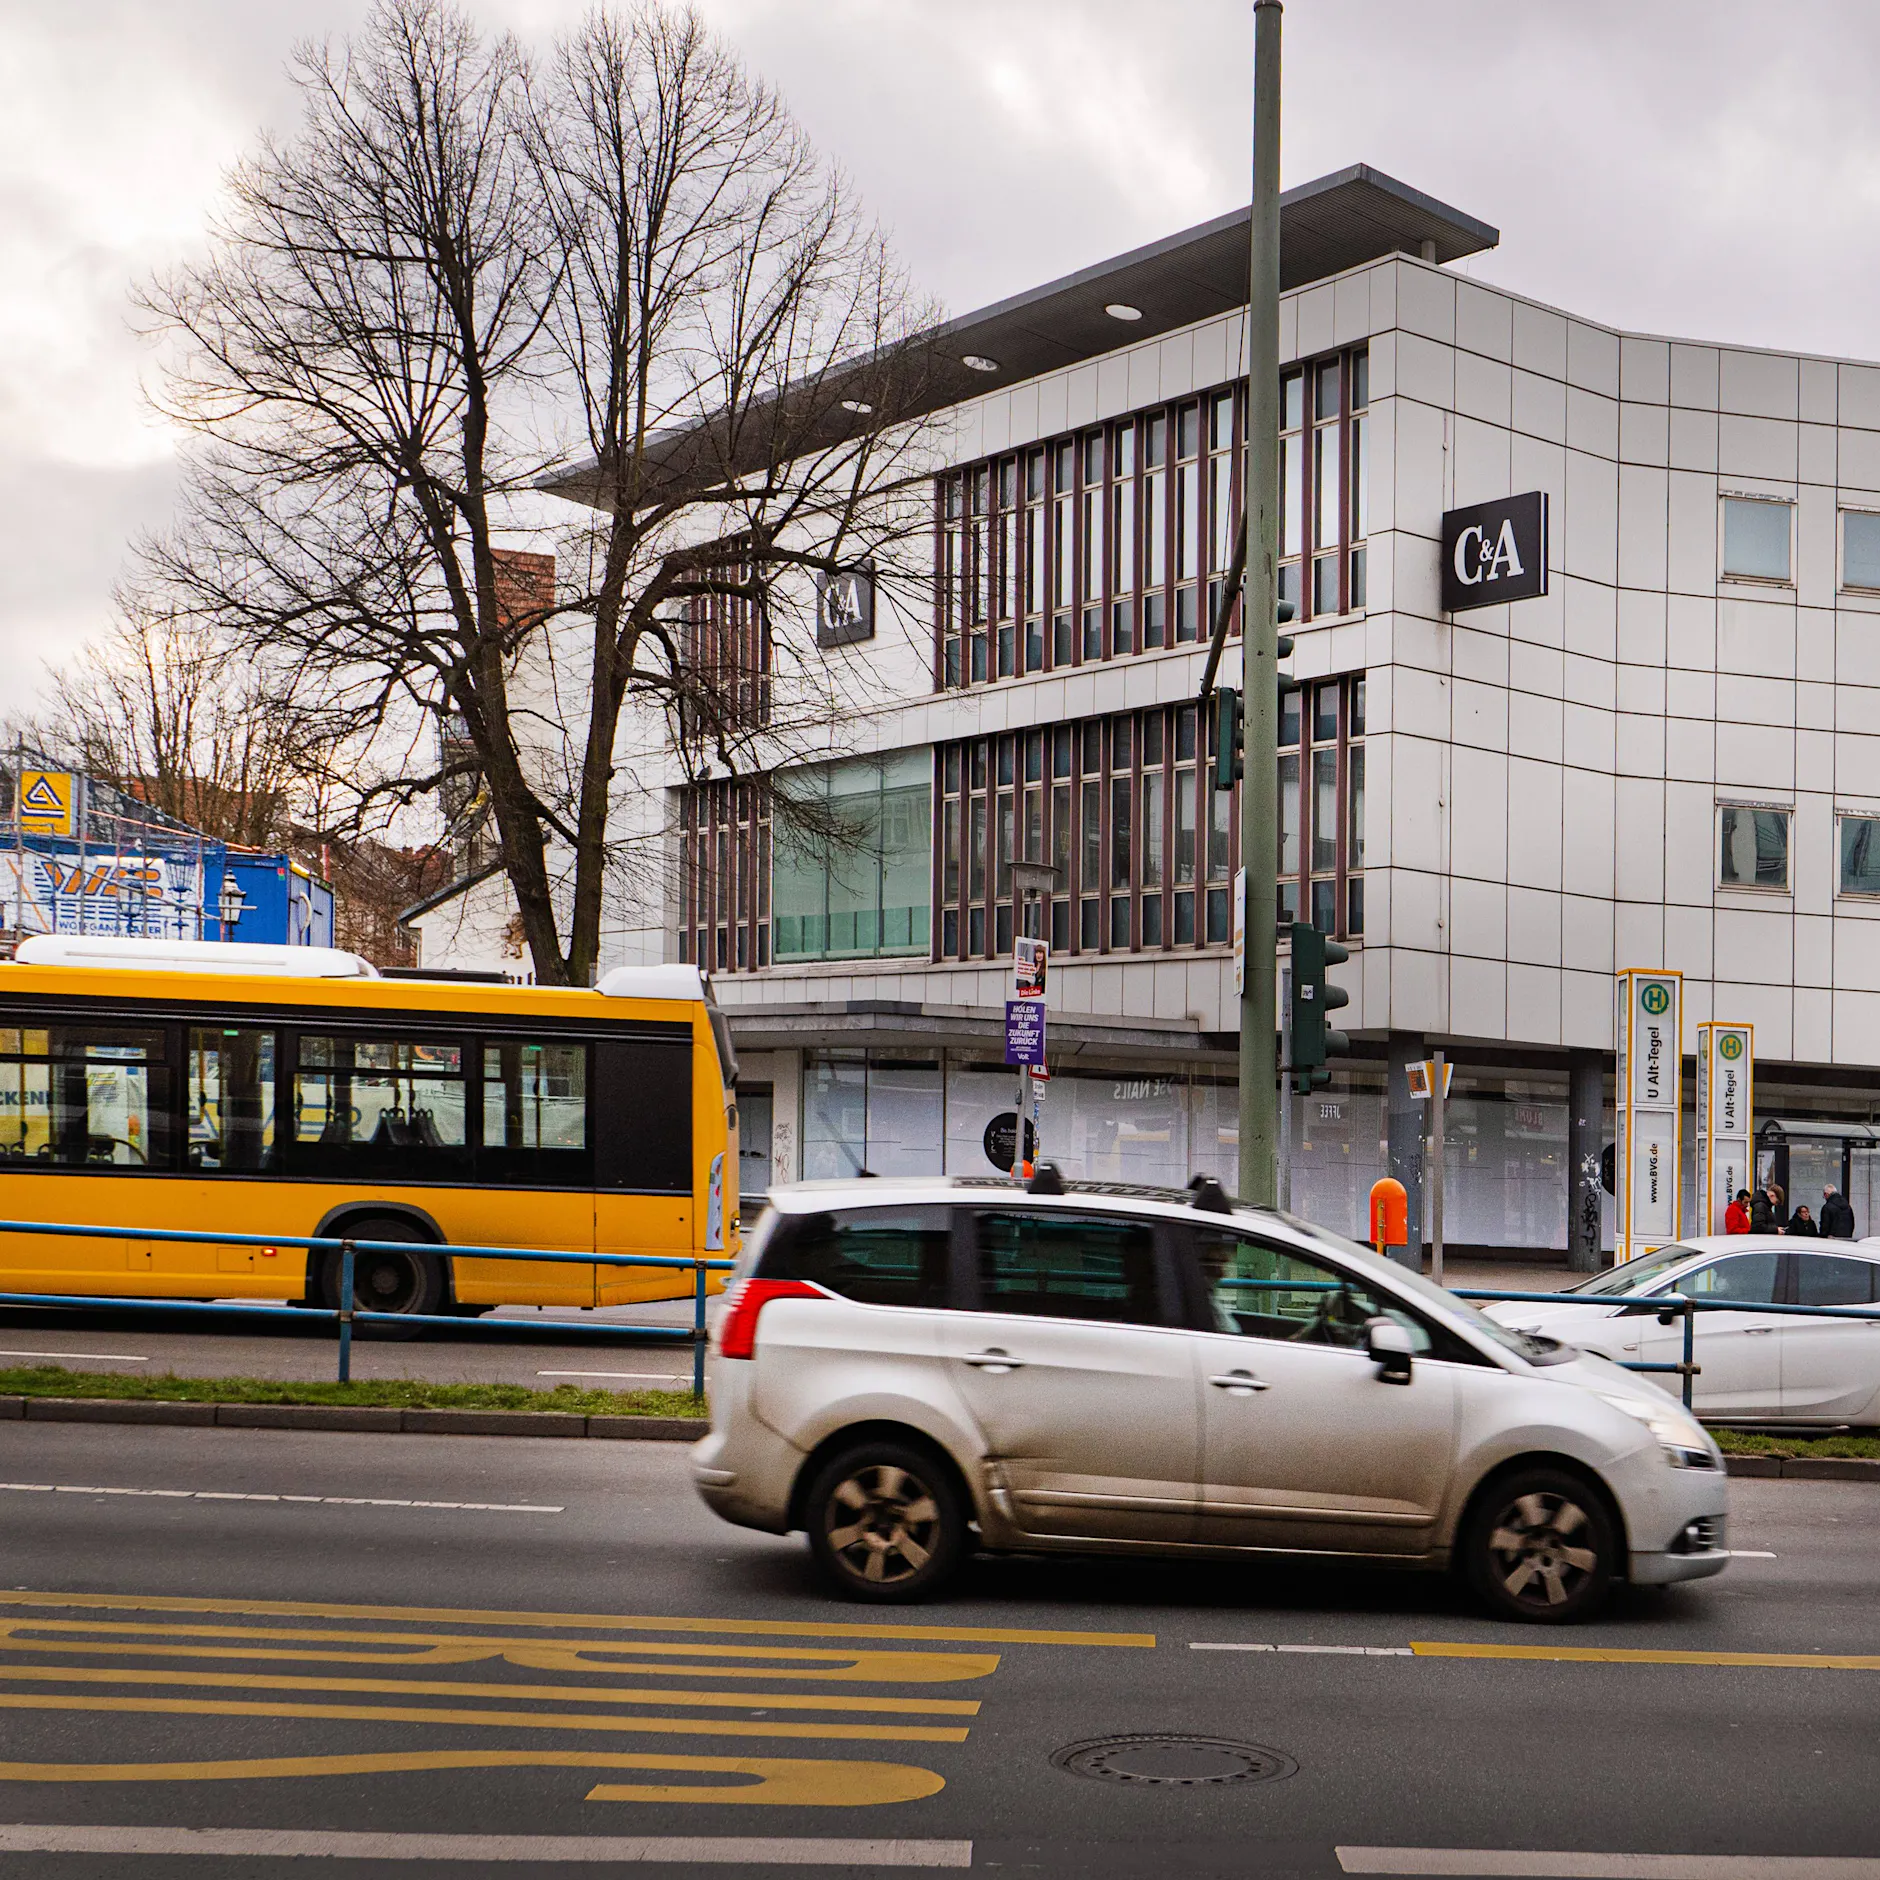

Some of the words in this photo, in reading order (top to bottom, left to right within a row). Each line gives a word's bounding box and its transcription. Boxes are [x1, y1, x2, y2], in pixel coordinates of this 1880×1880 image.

[1454, 518, 1524, 586] C&A
[823, 579, 863, 629] C&A
[1649, 991, 1662, 1008] H
[1010, 1013, 1023, 1021] WIR
[1012, 1005, 1036, 1013] HOLEN
[1008, 1029, 1040, 1037] ZUKUNFT
[1647, 1027, 1662, 1085] Alt-Tegel
[1648, 1089, 1659, 1098] U
[1725, 1069, 1737, 1117] Alt-Tegel
[1725, 1121, 1735, 1129] U
[1649, 1143, 1659, 1204] www.BVG.de
